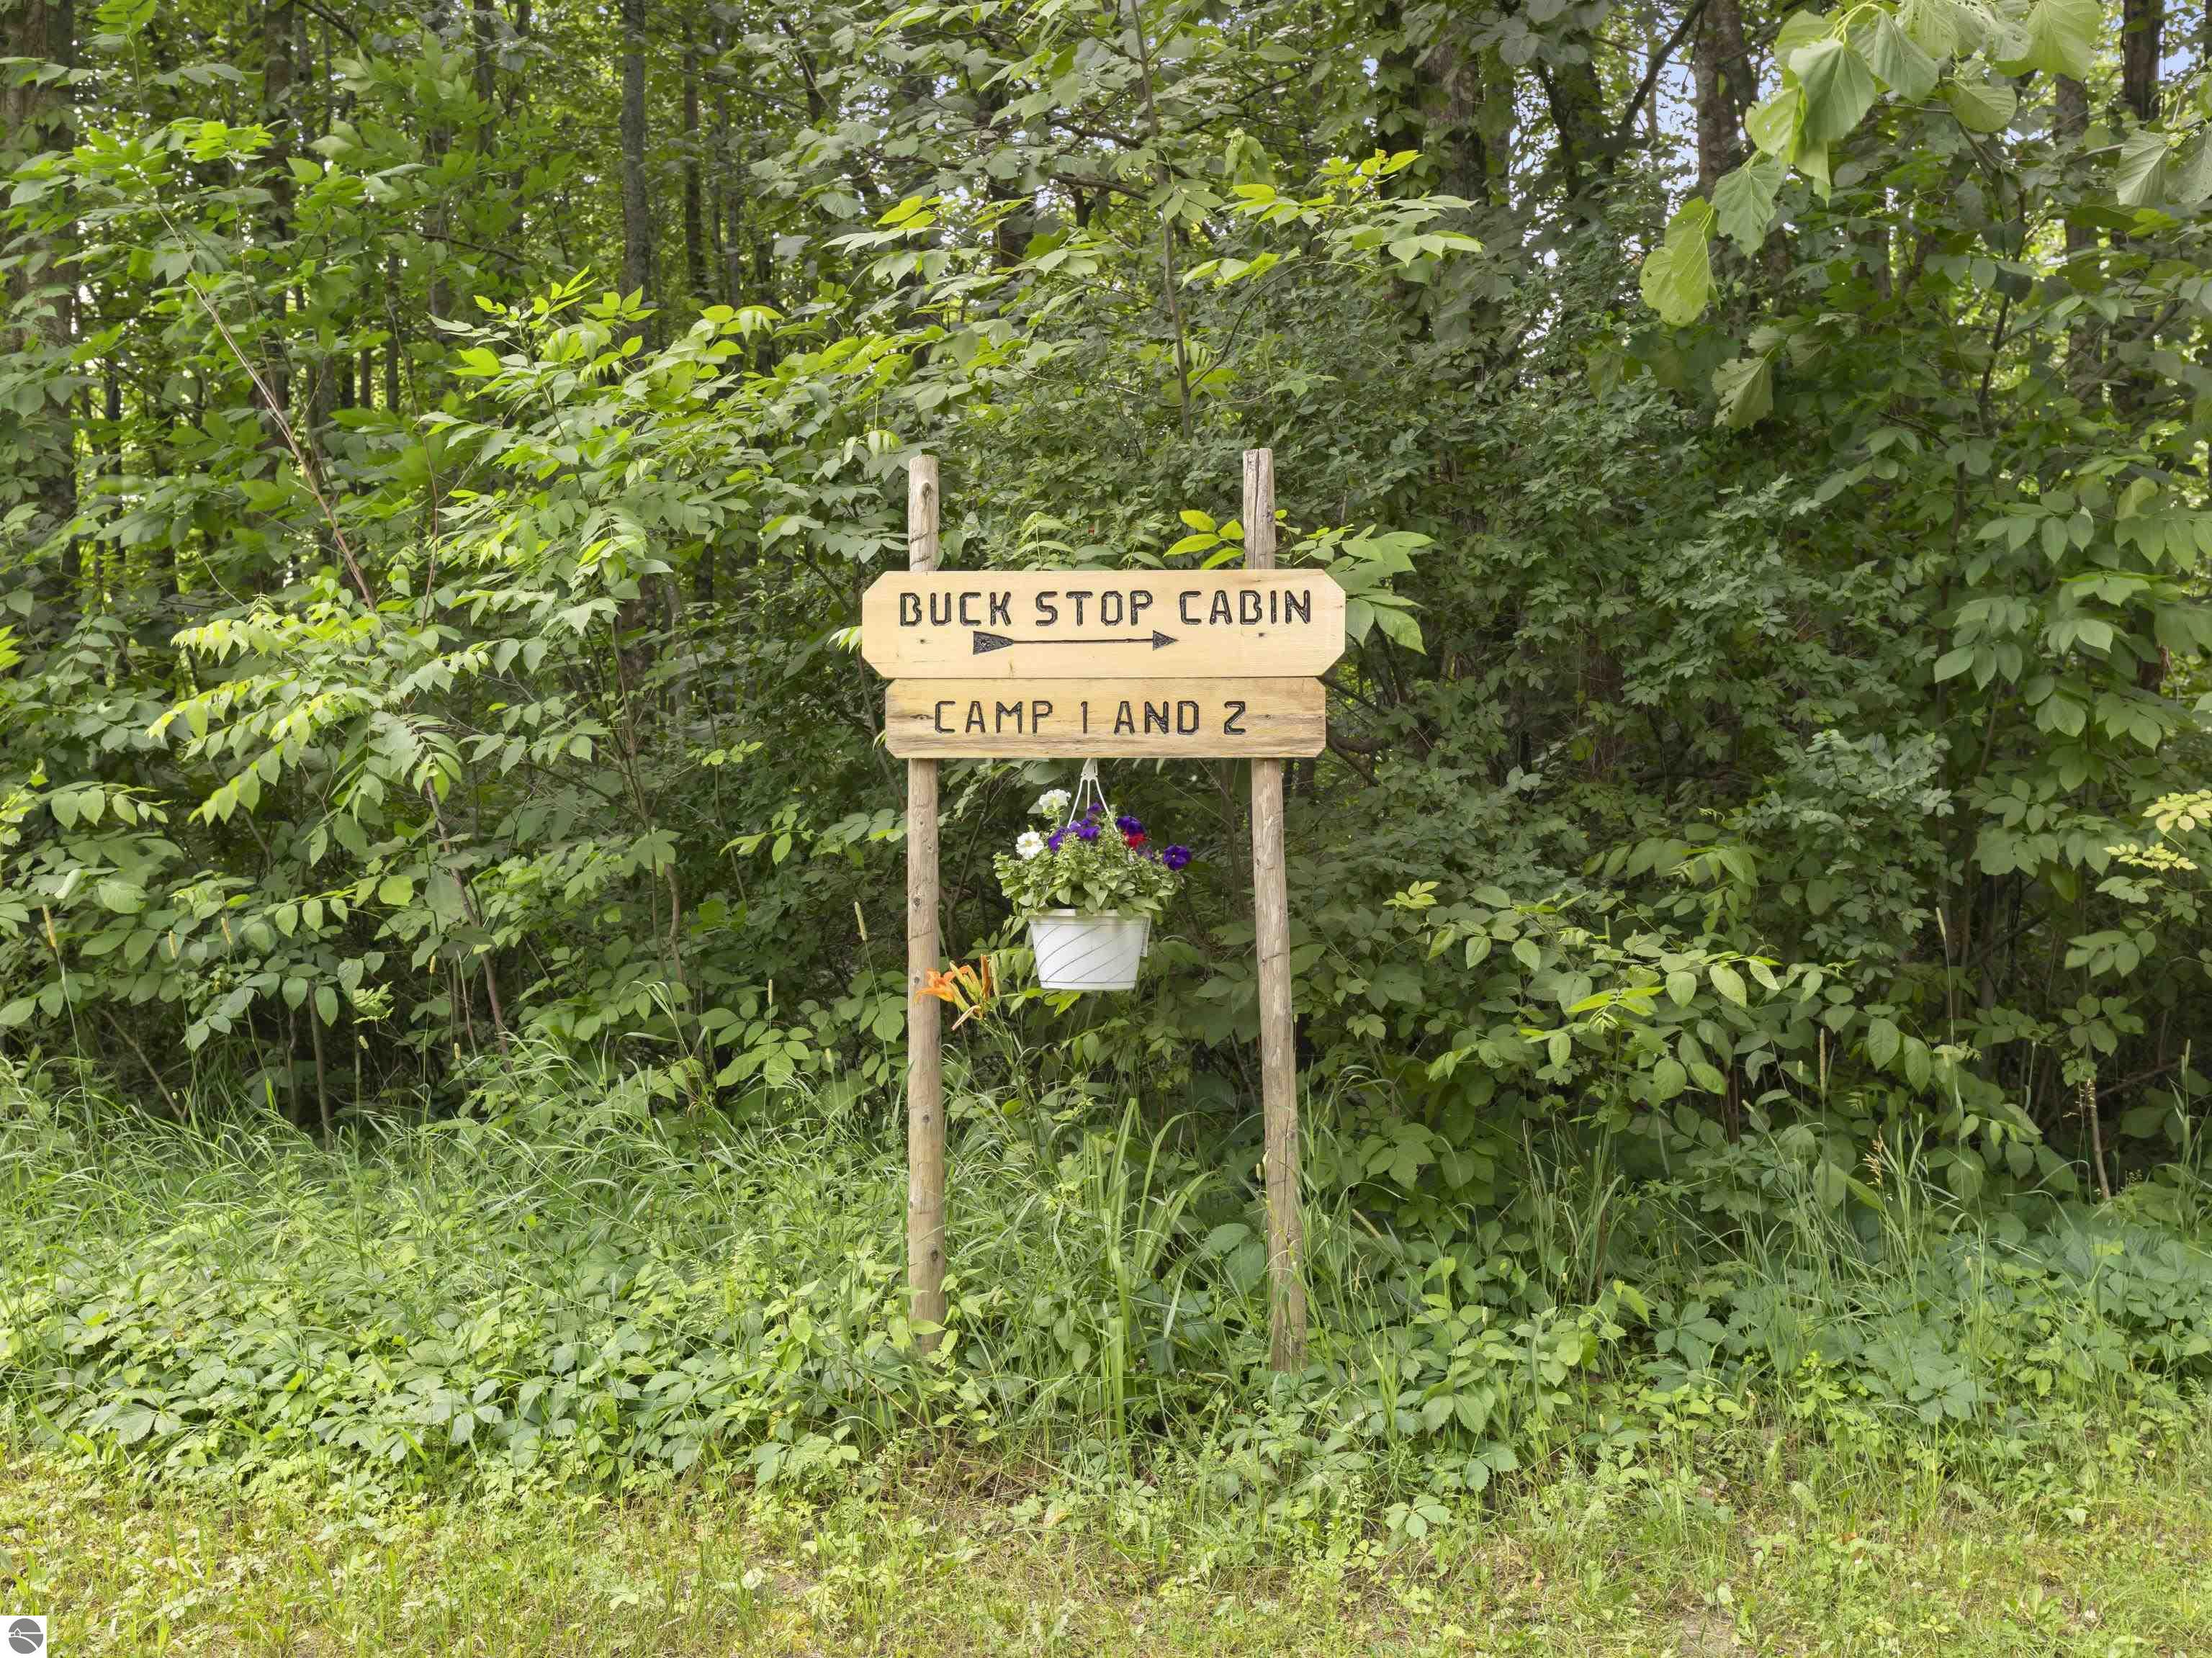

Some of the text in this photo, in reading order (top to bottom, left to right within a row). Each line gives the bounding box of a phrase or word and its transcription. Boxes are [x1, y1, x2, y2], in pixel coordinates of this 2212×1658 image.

[899, 590, 1310, 626] BUCK STOP CABIN
[935, 700, 1053, 734] CAMP
[1113, 700, 1200, 735] AND
[1223, 700, 1246, 735] 2
